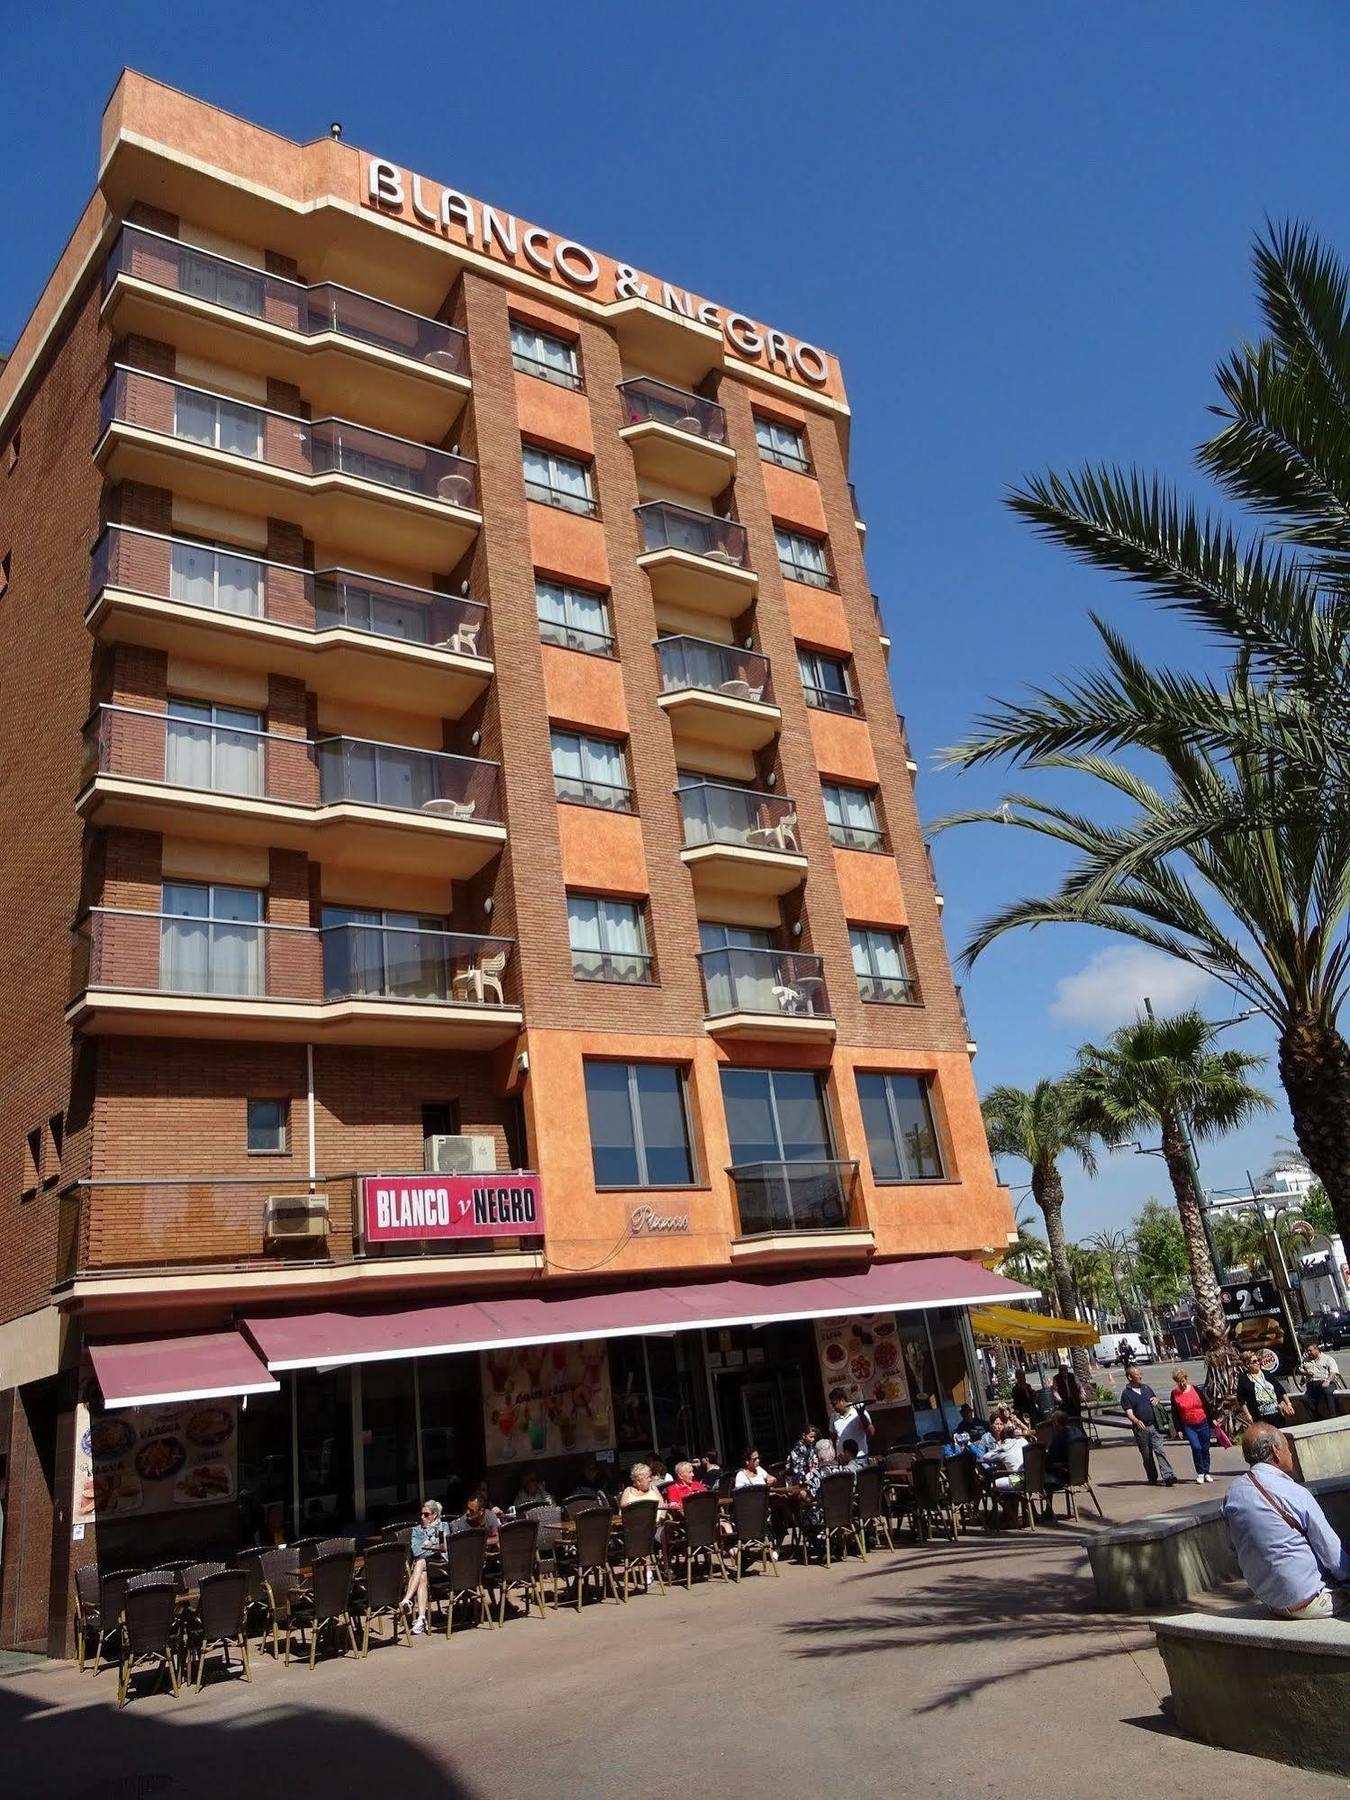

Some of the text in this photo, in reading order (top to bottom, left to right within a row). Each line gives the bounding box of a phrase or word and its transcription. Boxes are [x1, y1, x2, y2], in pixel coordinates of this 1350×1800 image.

[368, 158, 829, 384] BLANCO & NEGRO
[376, 1188, 450, 1228] BLANCO
[473, 1187, 537, 1226] NEGRO
